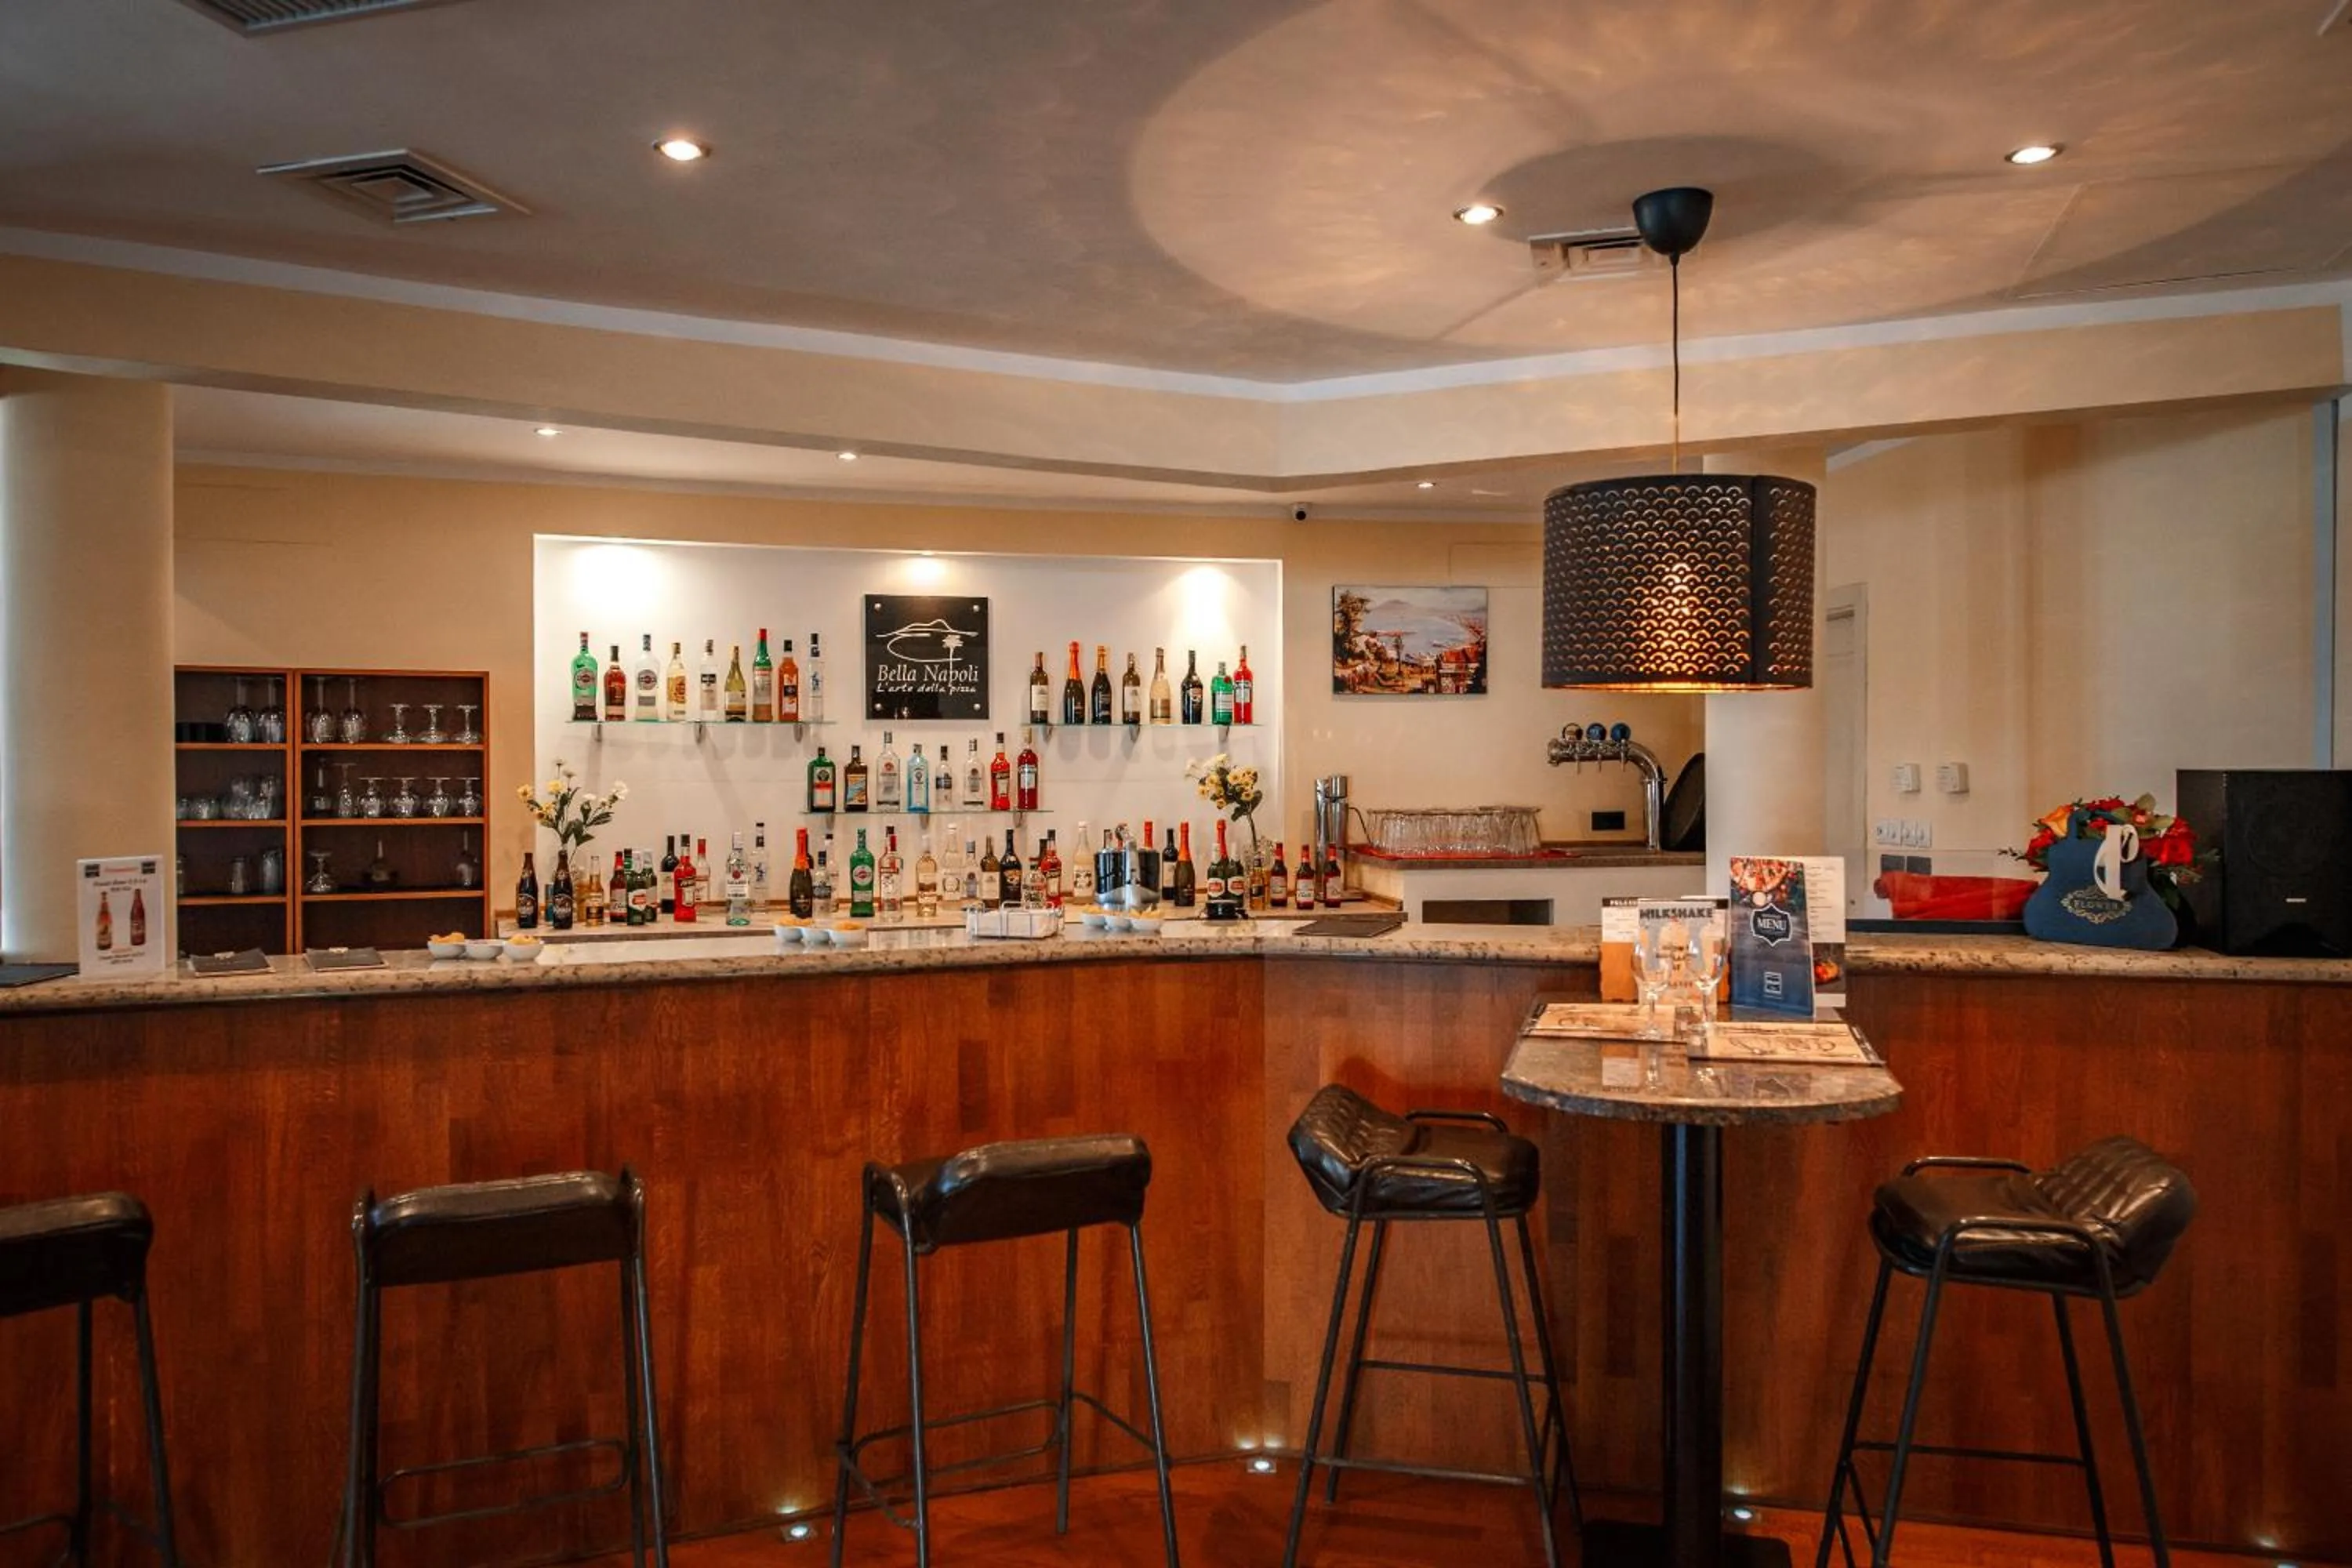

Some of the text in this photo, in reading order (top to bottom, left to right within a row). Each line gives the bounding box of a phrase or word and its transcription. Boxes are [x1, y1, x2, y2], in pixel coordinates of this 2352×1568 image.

[877, 664, 979, 686] Bella Napoli
[876, 682, 976, 695] L'arte della pizza
[1639, 908, 1713, 920] MILKSHAKE
[1757, 916, 1787, 931] MENU
